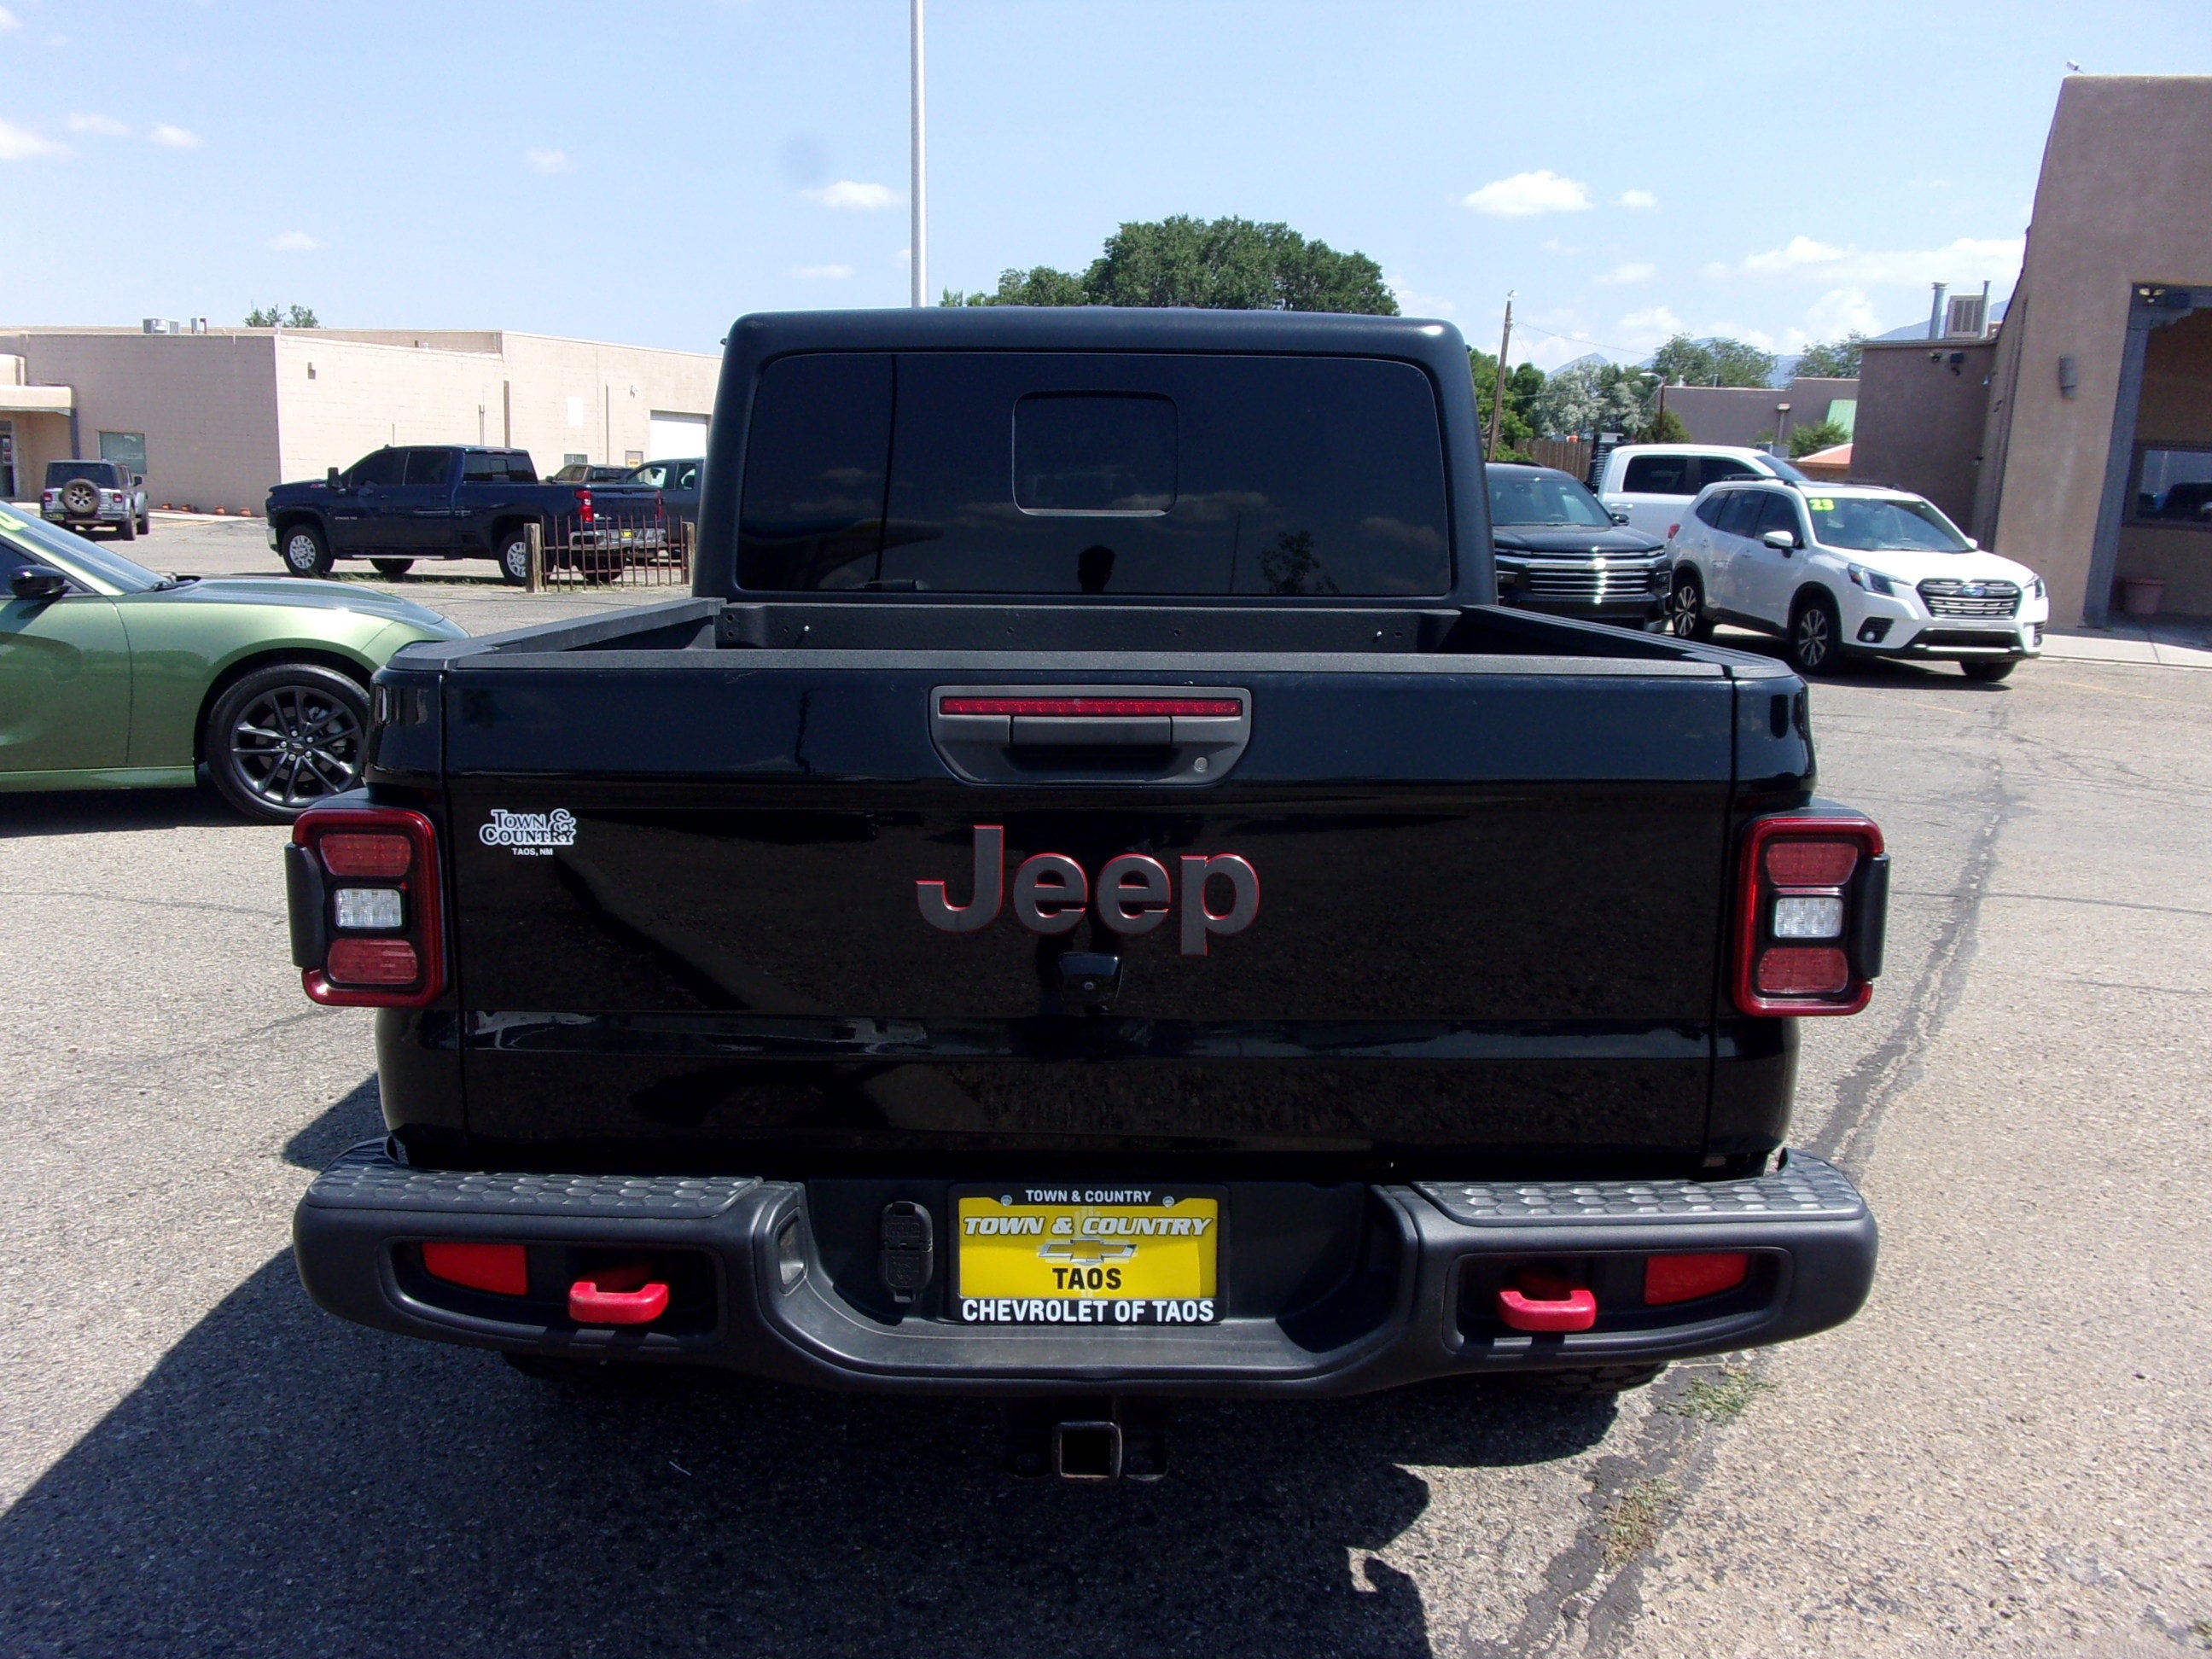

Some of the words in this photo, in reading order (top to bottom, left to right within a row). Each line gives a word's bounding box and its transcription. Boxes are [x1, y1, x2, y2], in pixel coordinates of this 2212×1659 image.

[1807, 498, 1834, 510] 23
[491, 809, 546, 830] TOWN
[550, 808, 576, 833] &
[480, 824, 576, 846] COUNTRY
[511, 847, 538, 856] TAOS,
[539, 847, 553, 856] NM
[916, 824, 1260, 956] Jeep
[1025, 1190, 1068, 1202] TOWN
[1071, 1190, 1081, 1202] &
[1085, 1190, 1152, 1203] COUNTRY
[963, 1216, 1044, 1236] TOWN
[1051, 1217, 1074, 1235] &
[1080, 1216, 1214, 1237] COUNTRY
[1052, 1267, 1122, 1290] TAOS
[963, 1300, 1108, 1323] CHEVROLET
[1115, 1301, 1145, 1323] OF
[1152, 1301, 1214, 1323] TAOS
